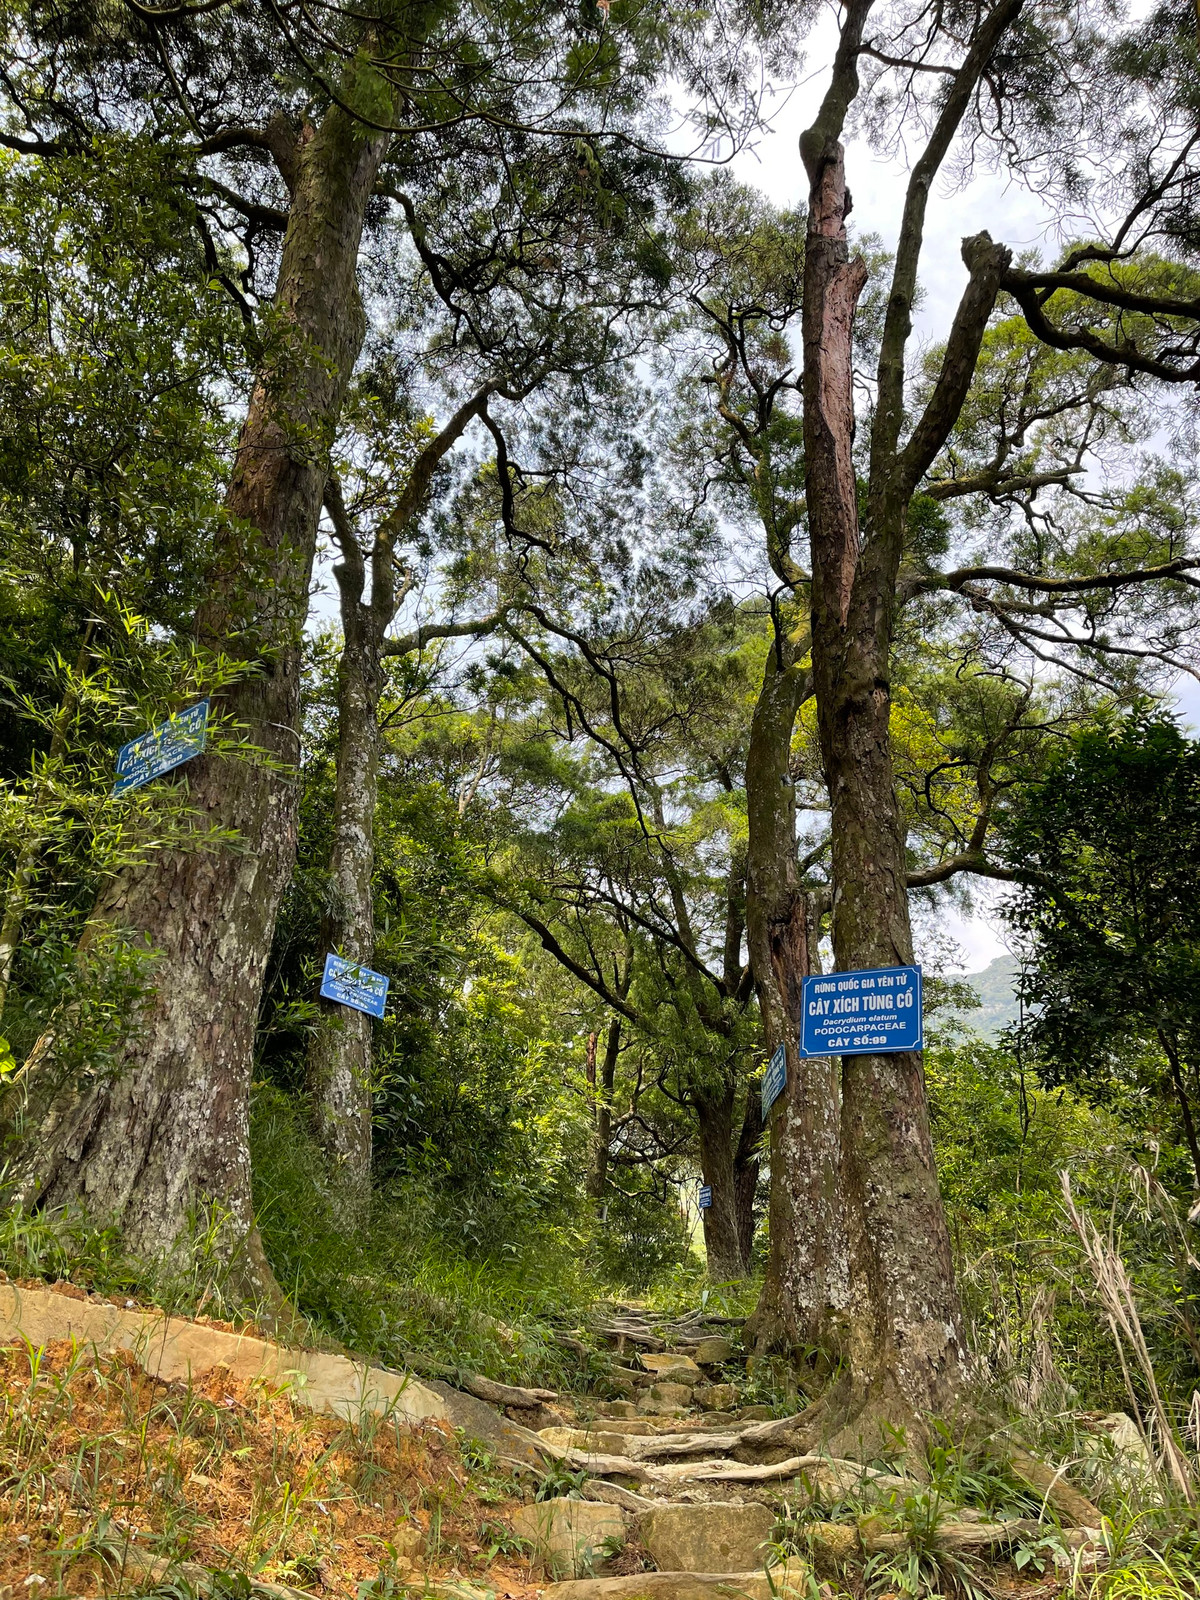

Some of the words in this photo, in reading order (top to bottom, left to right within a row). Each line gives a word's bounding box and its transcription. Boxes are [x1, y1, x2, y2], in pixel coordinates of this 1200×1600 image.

[814, 981, 836, 994] RỪNG
[837, 977, 860, 992] QUỐC
[861, 978, 875, 989] GIA
[877, 975, 894, 988] YÊN
[895, 972, 908, 986] TỬ
[808, 998, 831, 1016] CÂY
[832, 995, 860, 1014] XÍCH
[862, 992, 894, 1011] TÙNG
[896, 986, 914, 1009] CỔ
[822, 1015, 867, 1026] Dacrydium
[868, 1014, 898, 1023] elatum
[814, 1021, 907, 1036] PODOCARPACEAE
[827, 1036, 851, 1048] CÂY
